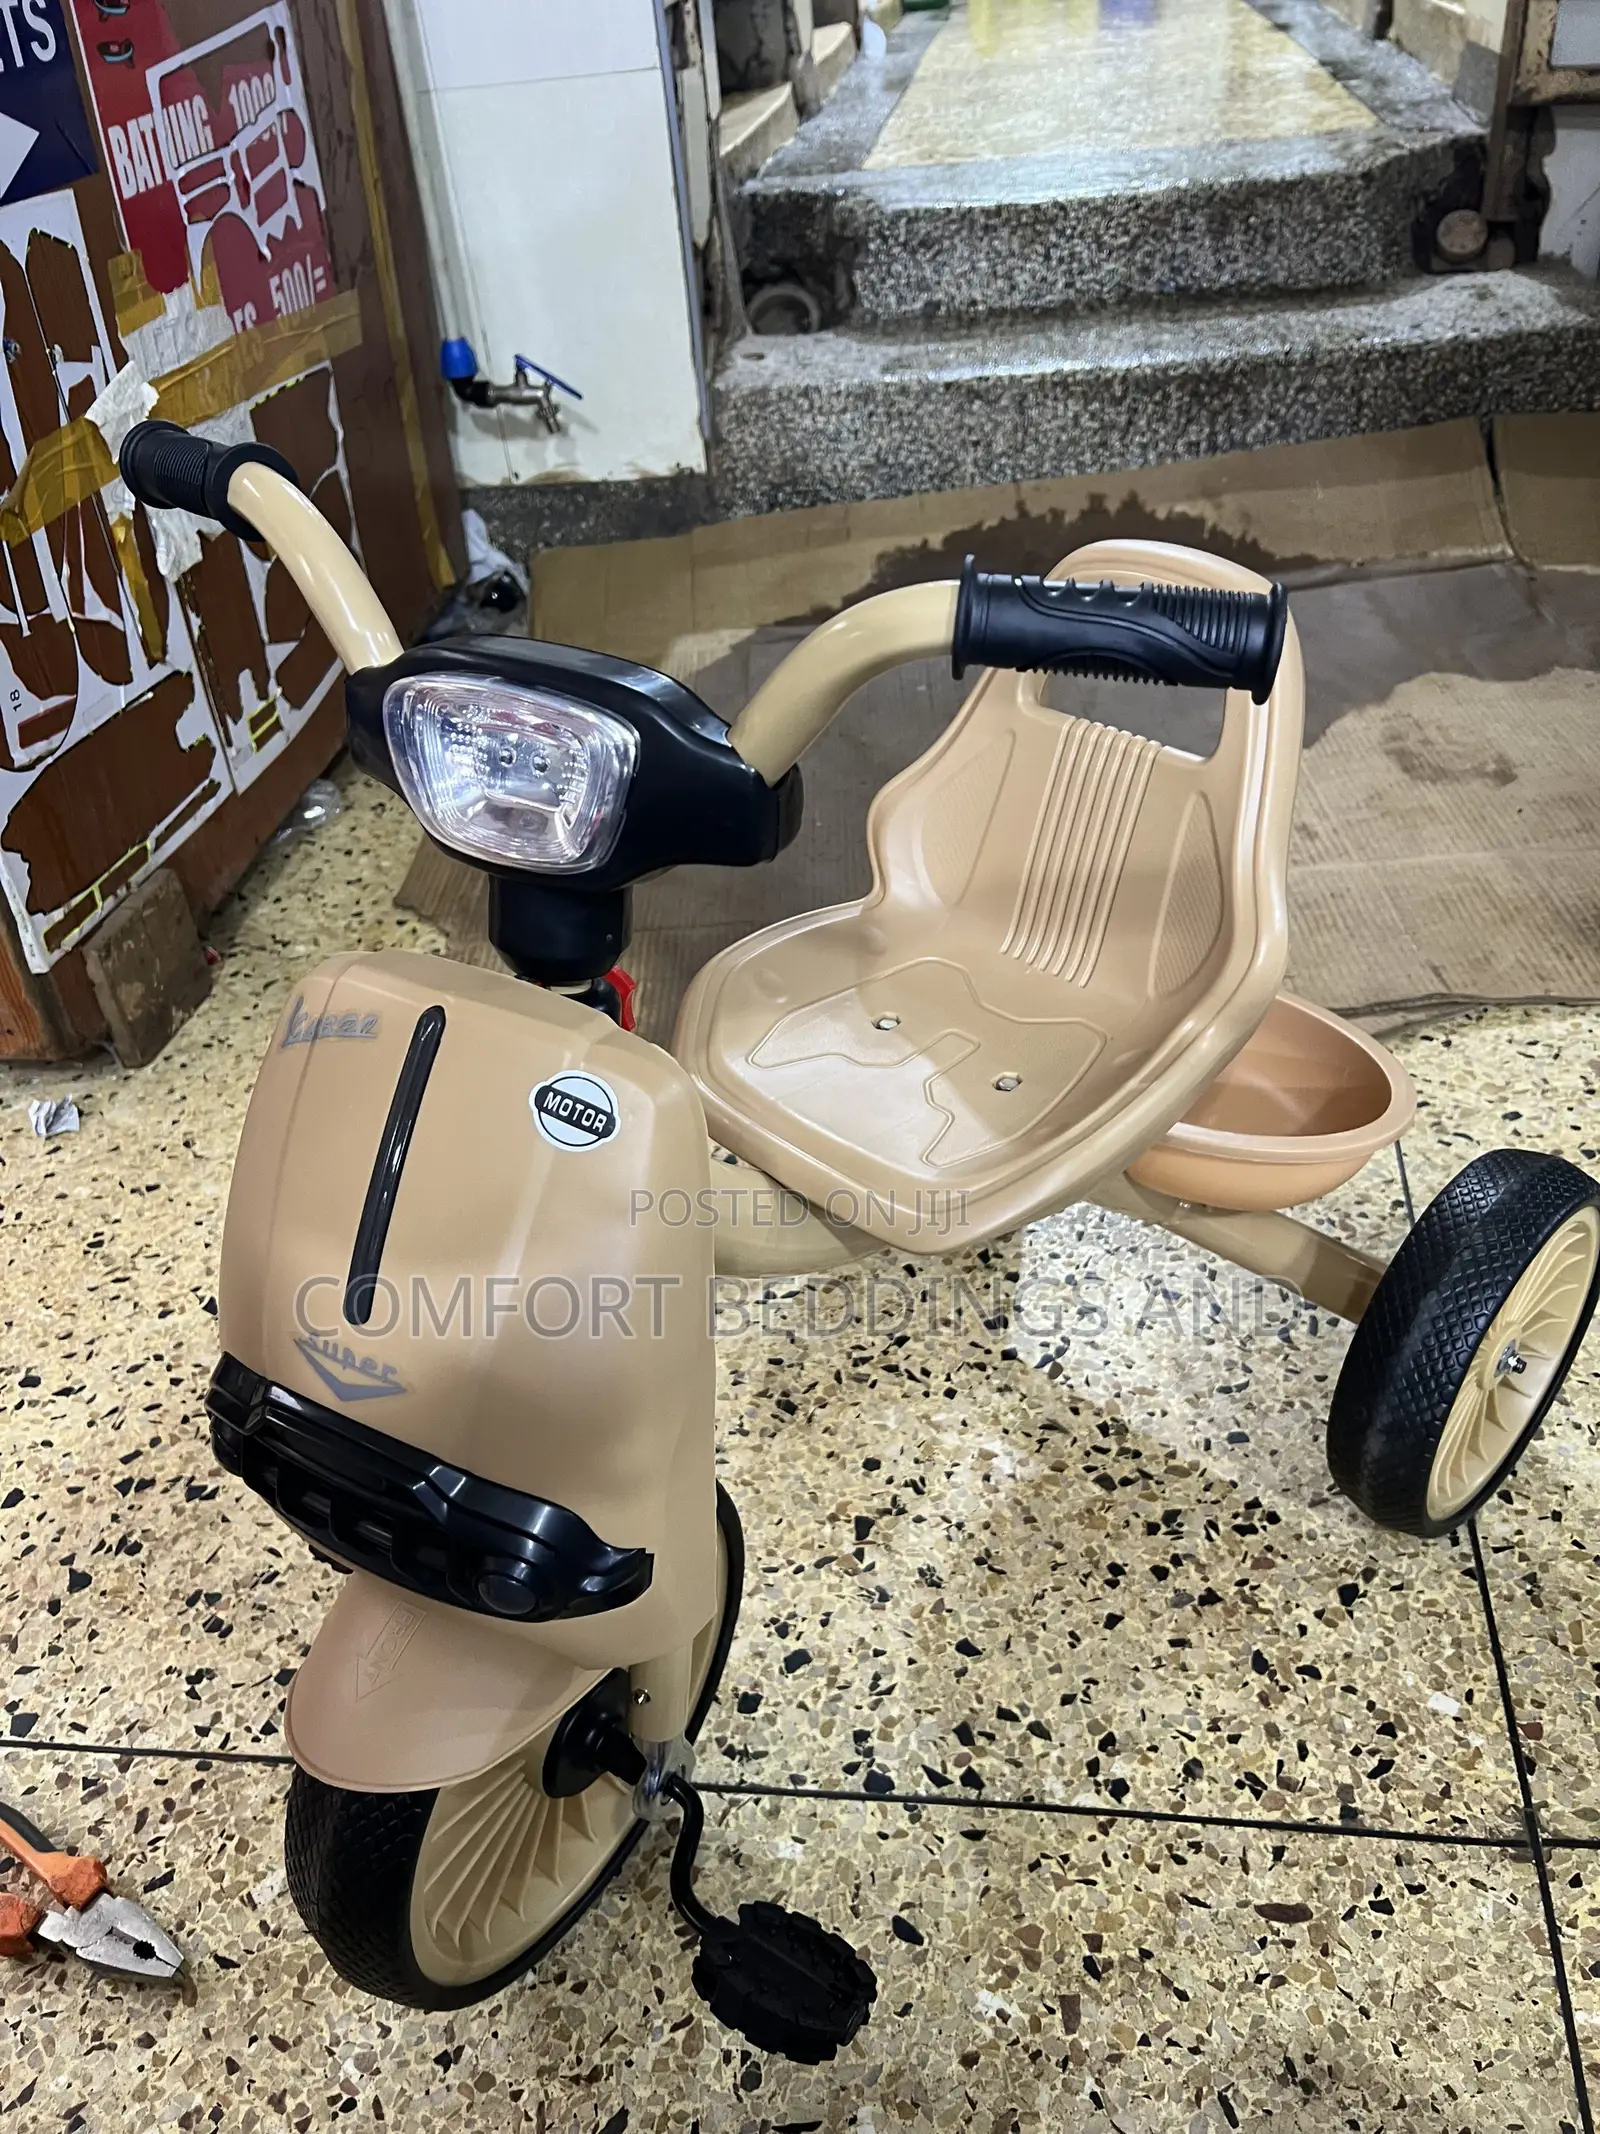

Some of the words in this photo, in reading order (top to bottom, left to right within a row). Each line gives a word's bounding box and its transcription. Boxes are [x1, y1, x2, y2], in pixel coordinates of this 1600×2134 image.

[0, 0, 56, 73] TS
[543, 1091, 608, 1133] MOTOR
[297, 1331, 399, 1384] Super
